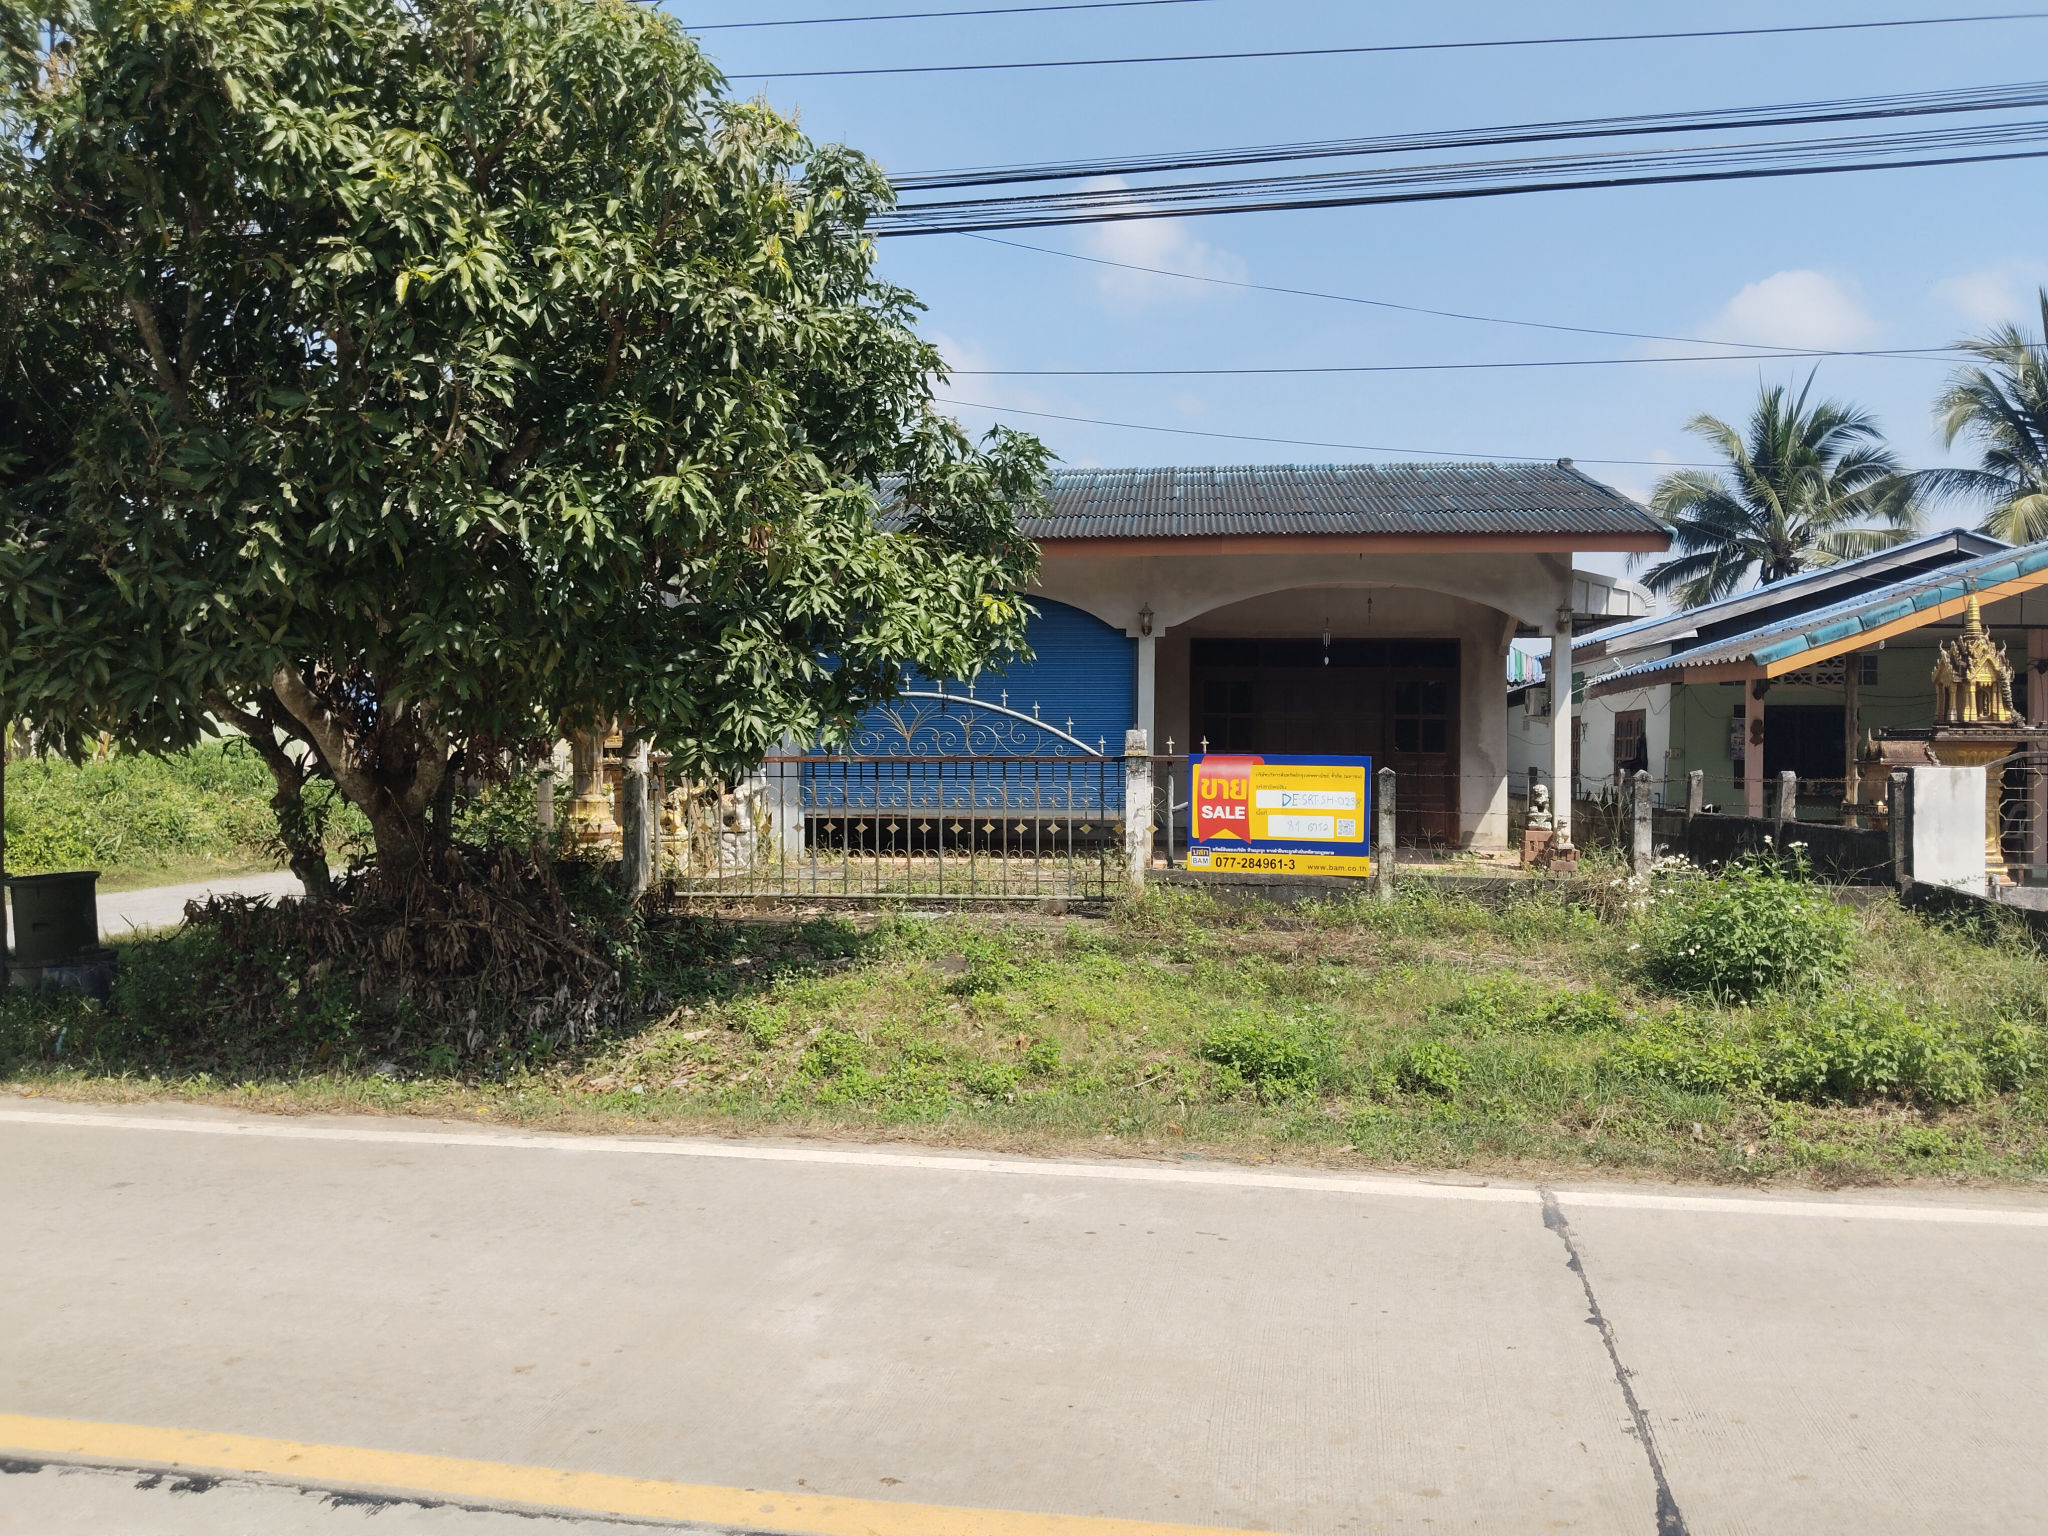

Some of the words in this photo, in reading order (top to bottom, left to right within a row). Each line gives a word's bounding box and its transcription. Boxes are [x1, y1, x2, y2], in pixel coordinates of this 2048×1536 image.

[1200, 778, 1247, 800] ขาย
[1201, 805, 1246, 820] SALE
[1192, 857, 1209, 865] BAM
[1215, 856, 1296, 870] 077-284961-3
[1307, 864, 1367, 872] www.bam.co.th
